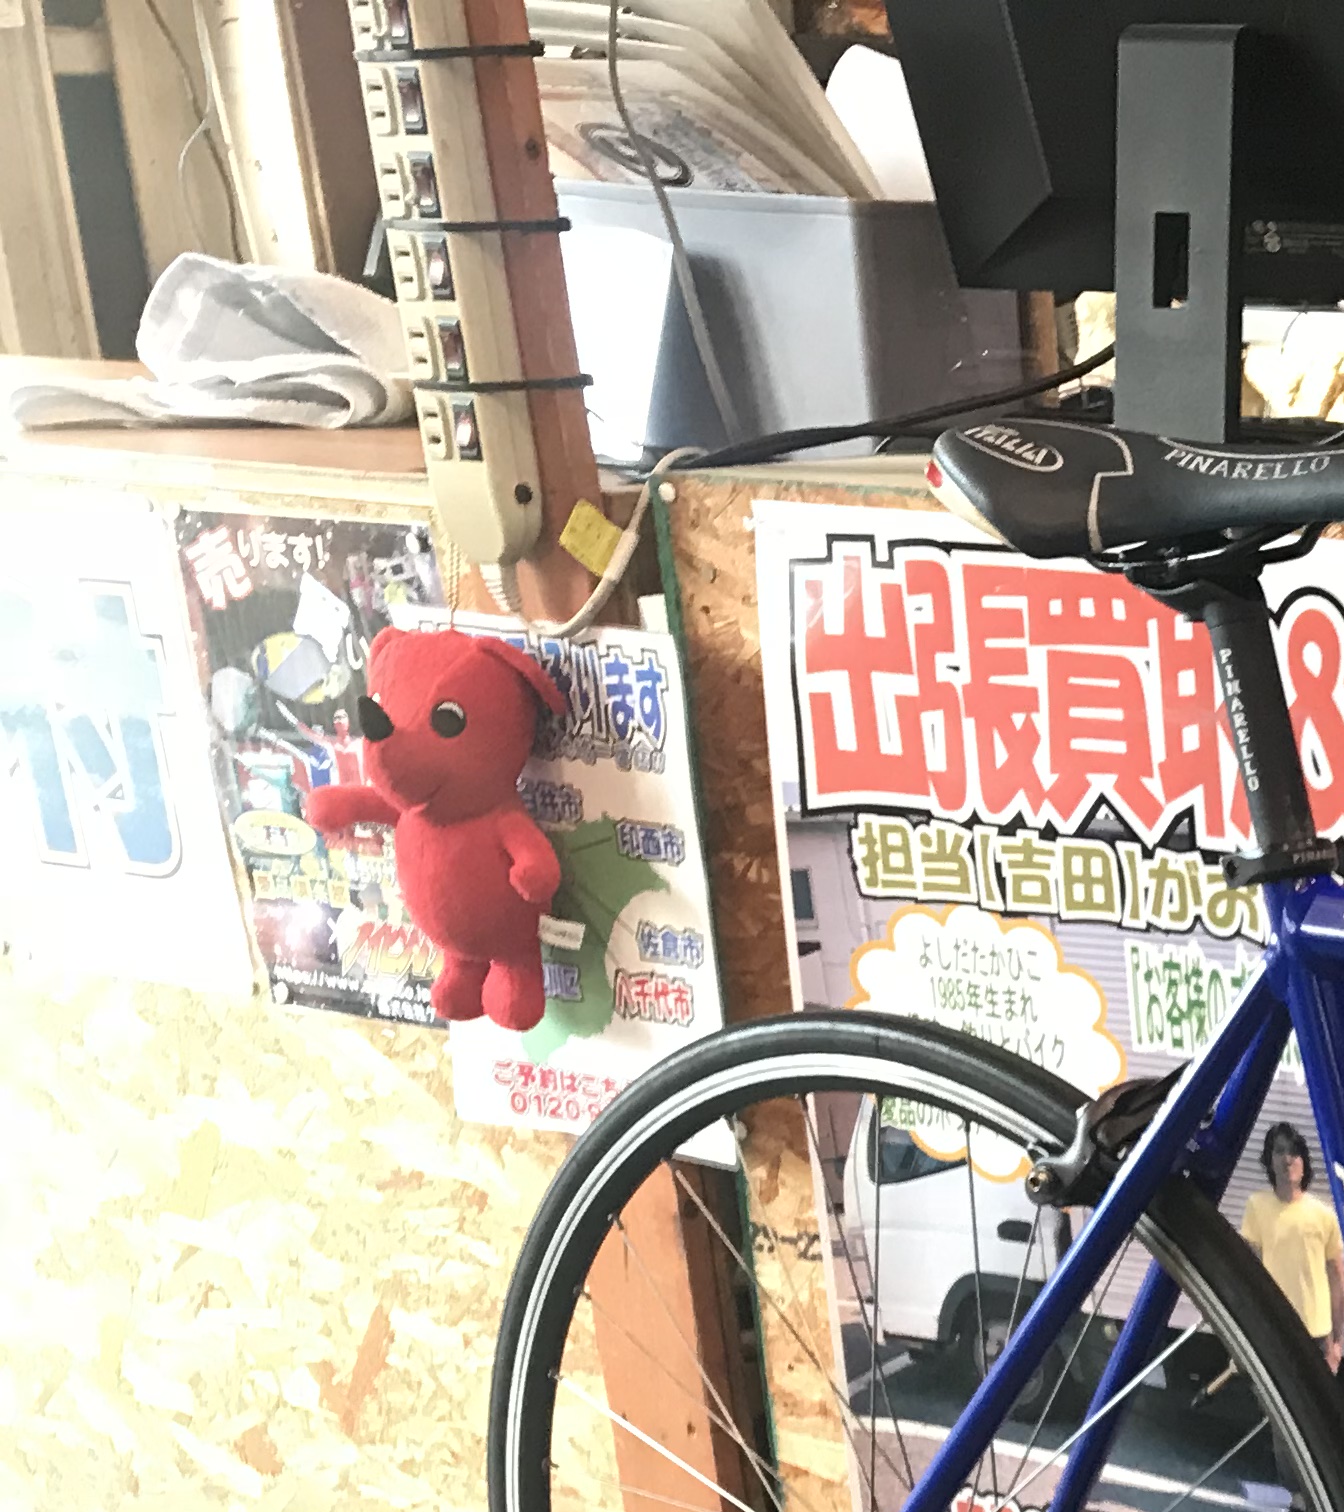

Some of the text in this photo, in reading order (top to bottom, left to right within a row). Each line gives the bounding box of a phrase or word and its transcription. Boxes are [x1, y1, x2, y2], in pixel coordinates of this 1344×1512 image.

[1165, 447, 1331, 481] PINARELLO
[1219, 648, 1260, 792] PINARELLO
[616, 971, 692, 1025] 八千代市
